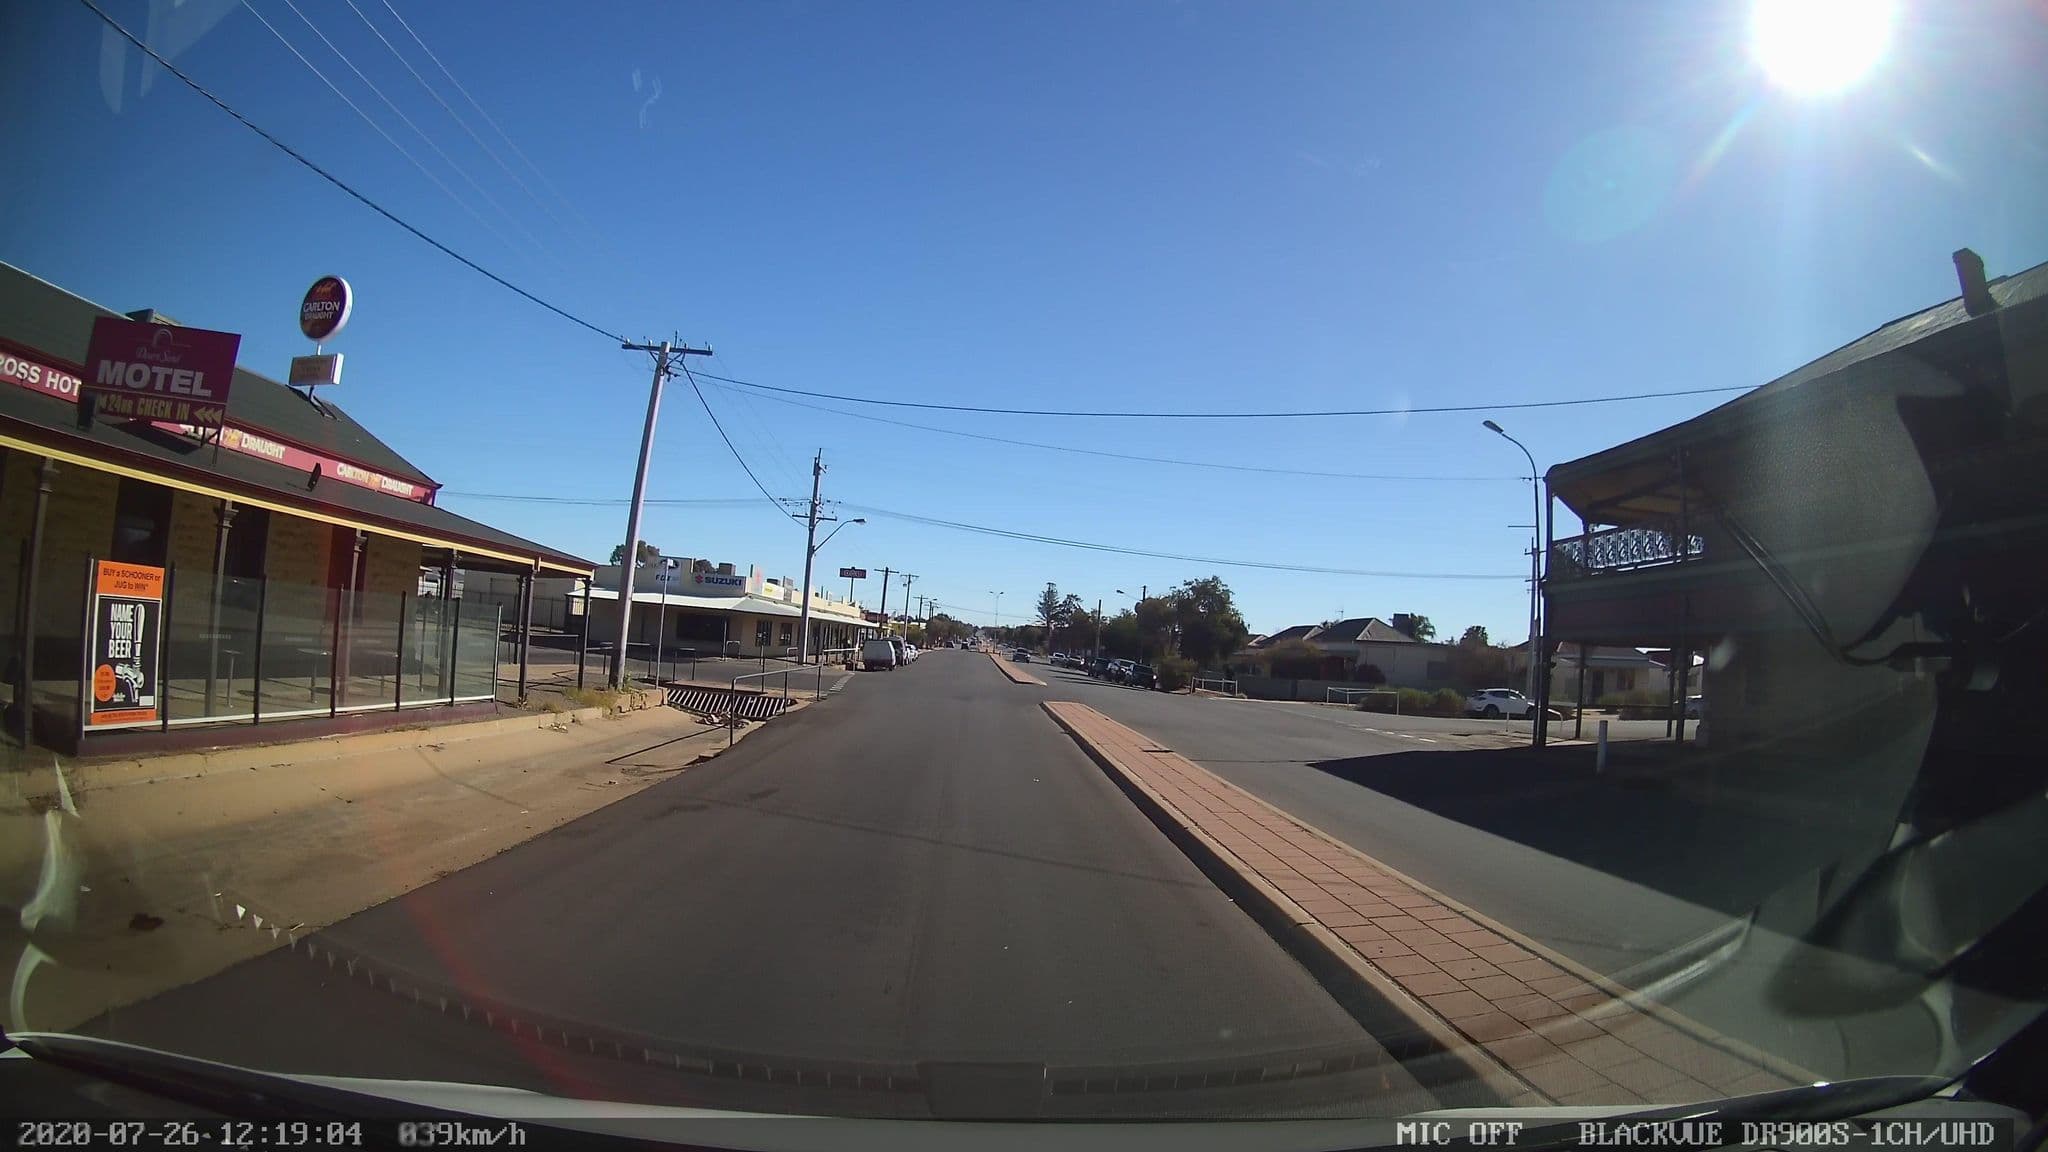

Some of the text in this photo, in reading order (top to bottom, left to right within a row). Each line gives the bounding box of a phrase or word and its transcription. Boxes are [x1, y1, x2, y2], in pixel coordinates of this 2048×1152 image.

[303, 301, 340, 313] CARLTON
[45, 371, 82, 397] HOT
[97, 359, 212, 398] MOTEL
[137, 398, 172, 419] CHECK
[176, 402, 190, 421] IN
[241, 432, 285, 459] DRAUGHT
[381, 476, 414, 496] DRAUGHT
[103, 567, 115, 577] BUY
[120, 569, 155, 582] SCHOONER
[704, 575, 742, 586] SUZUKI
[111, 603, 134, 622] NAME
[110, 621, 133, 640] YOUR
[108, 639, 132, 659] BEER
